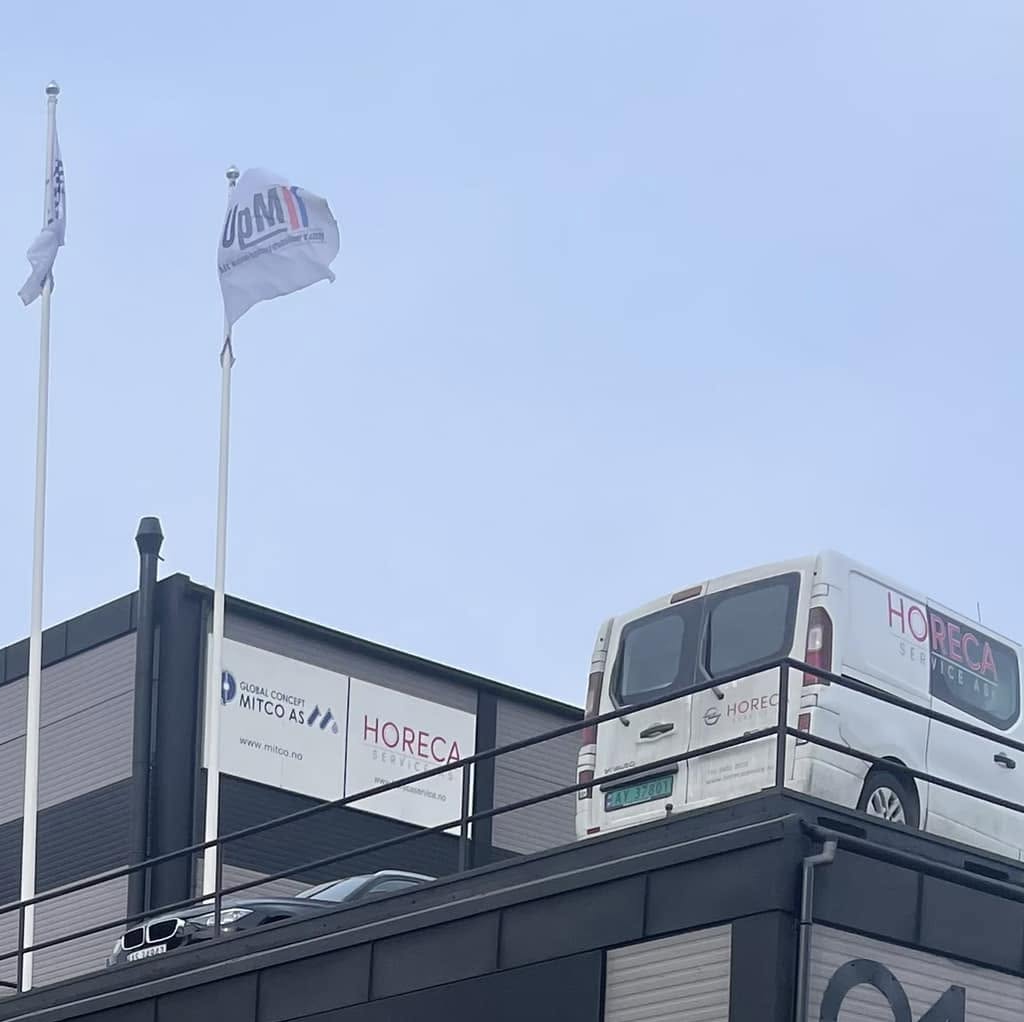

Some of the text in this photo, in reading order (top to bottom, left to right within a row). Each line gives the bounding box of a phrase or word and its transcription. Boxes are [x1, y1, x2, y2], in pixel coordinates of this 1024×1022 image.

[887, 591, 997, 681] HORECA
[899, 642, 964, 685] SERVICE
[239, 681, 305, 708] GLOBAL CONCEPT
[239, 693, 305, 724] MITCO AS
[727, 693, 780, 717] HOREC
[239, 737, 303, 760] www.mitco.no
[364, 714, 461, 764] HORECA
